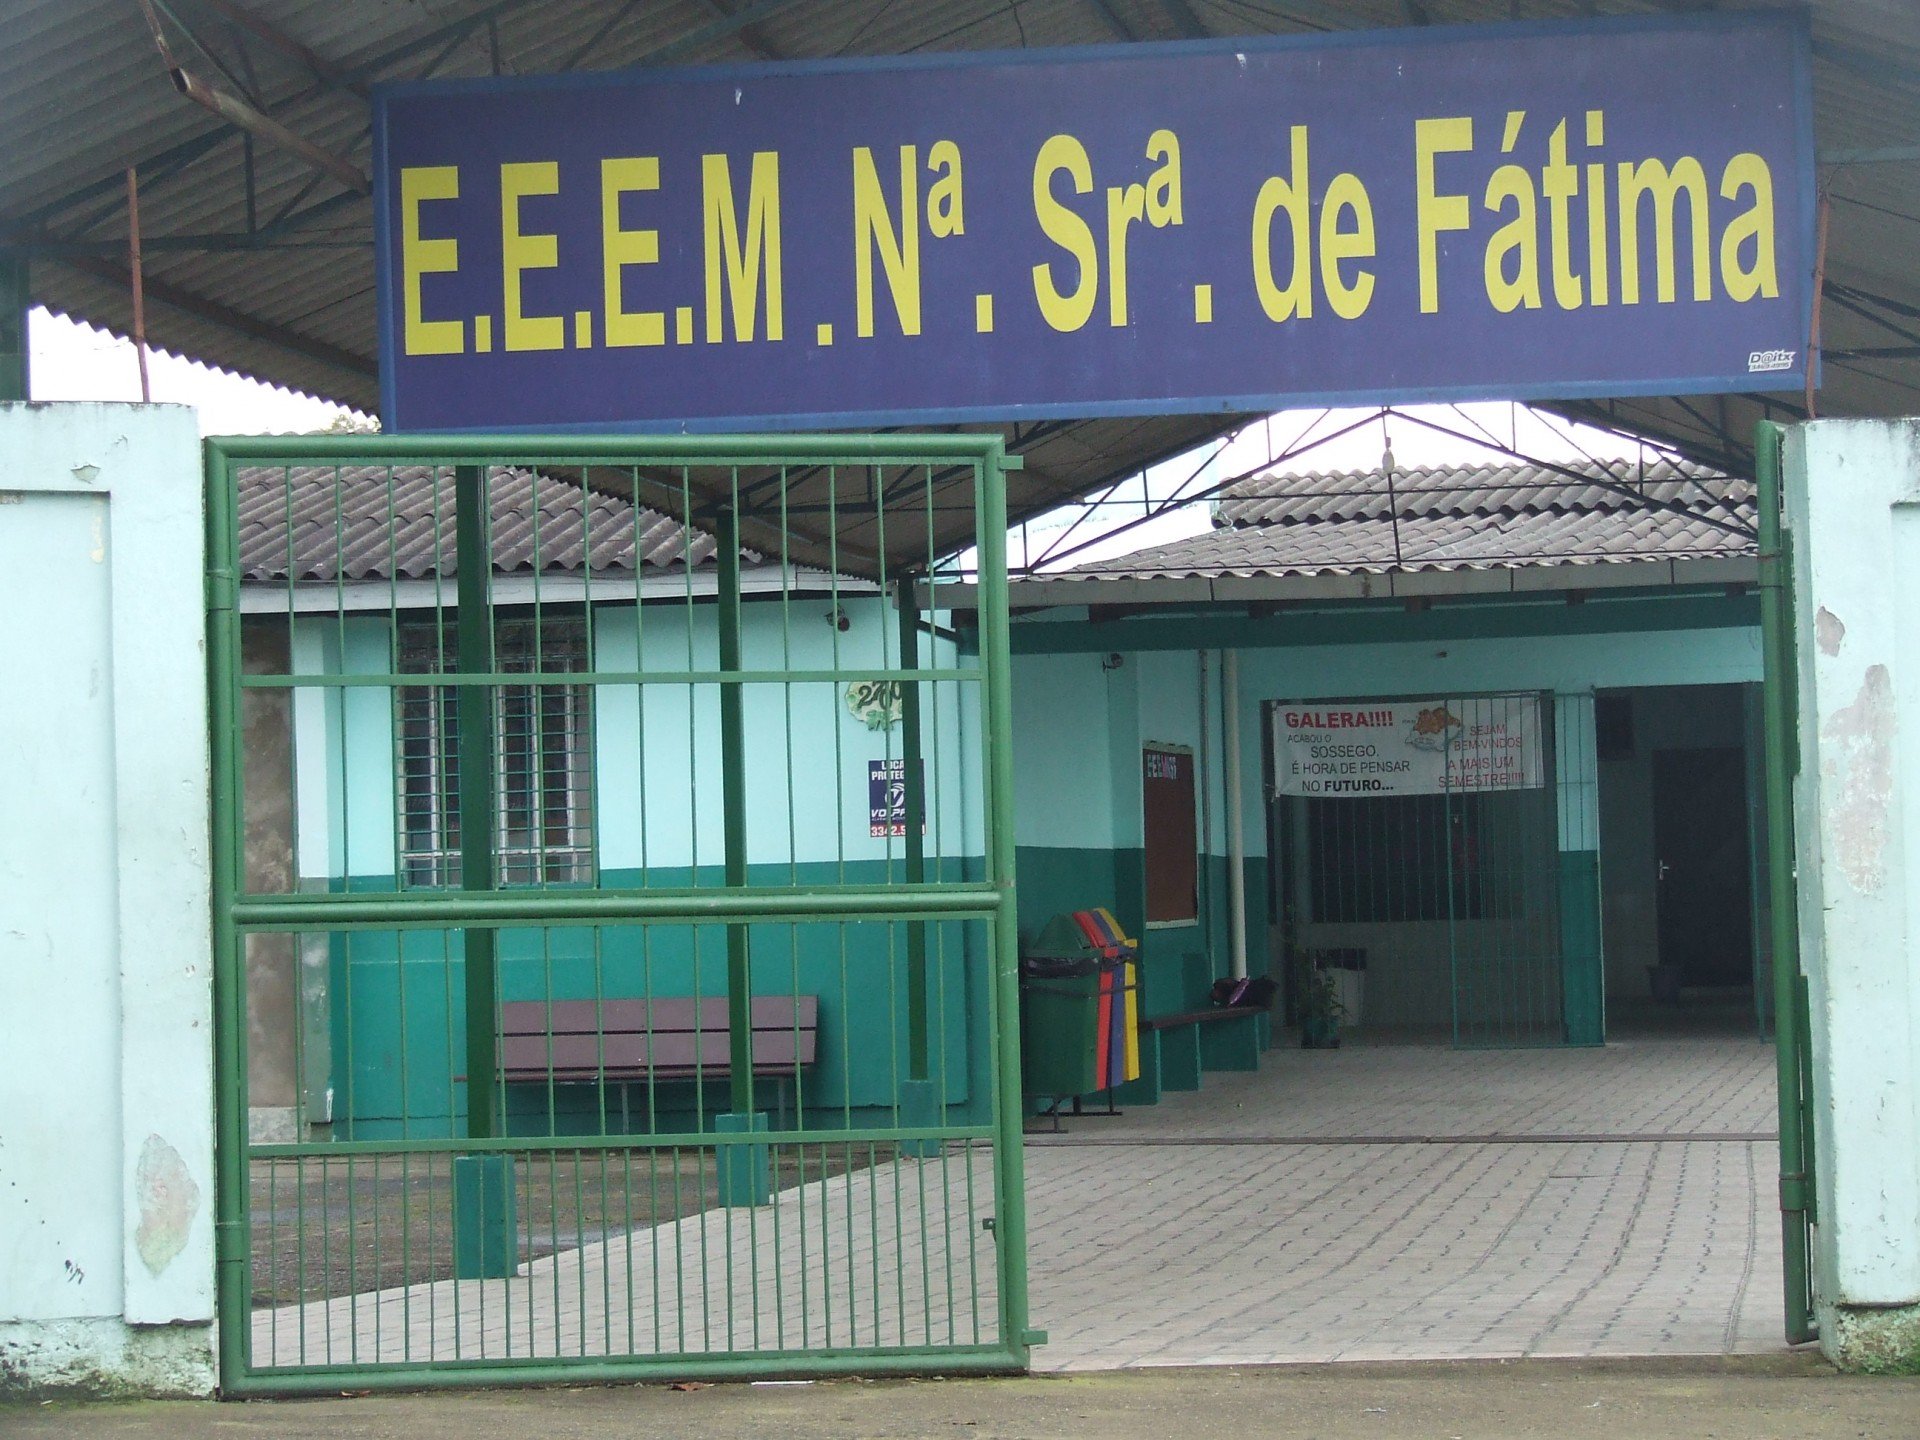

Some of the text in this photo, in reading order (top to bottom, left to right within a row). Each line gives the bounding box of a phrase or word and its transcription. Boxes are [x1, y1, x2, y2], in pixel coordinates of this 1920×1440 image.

[1252, 125, 1376, 322] de
[1415, 110, 1779, 313] Fátima
[1285, 711, 1393, 728] GALERA!!!!
[1470, 724, 1505, 736] SEJAM
[1287, 734, 1332, 743] ACABOU O
[1454, 737, 1521, 751] BEM-VINDOS
[1310, 745, 1379, 758] SOSSEGO.
[1291, 760, 1410, 775] É HORA DE PENSAR
[1447, 756, 1514, 770] A MAIS UM
[1302, 779, 1394, 792] NO FUTURO...
